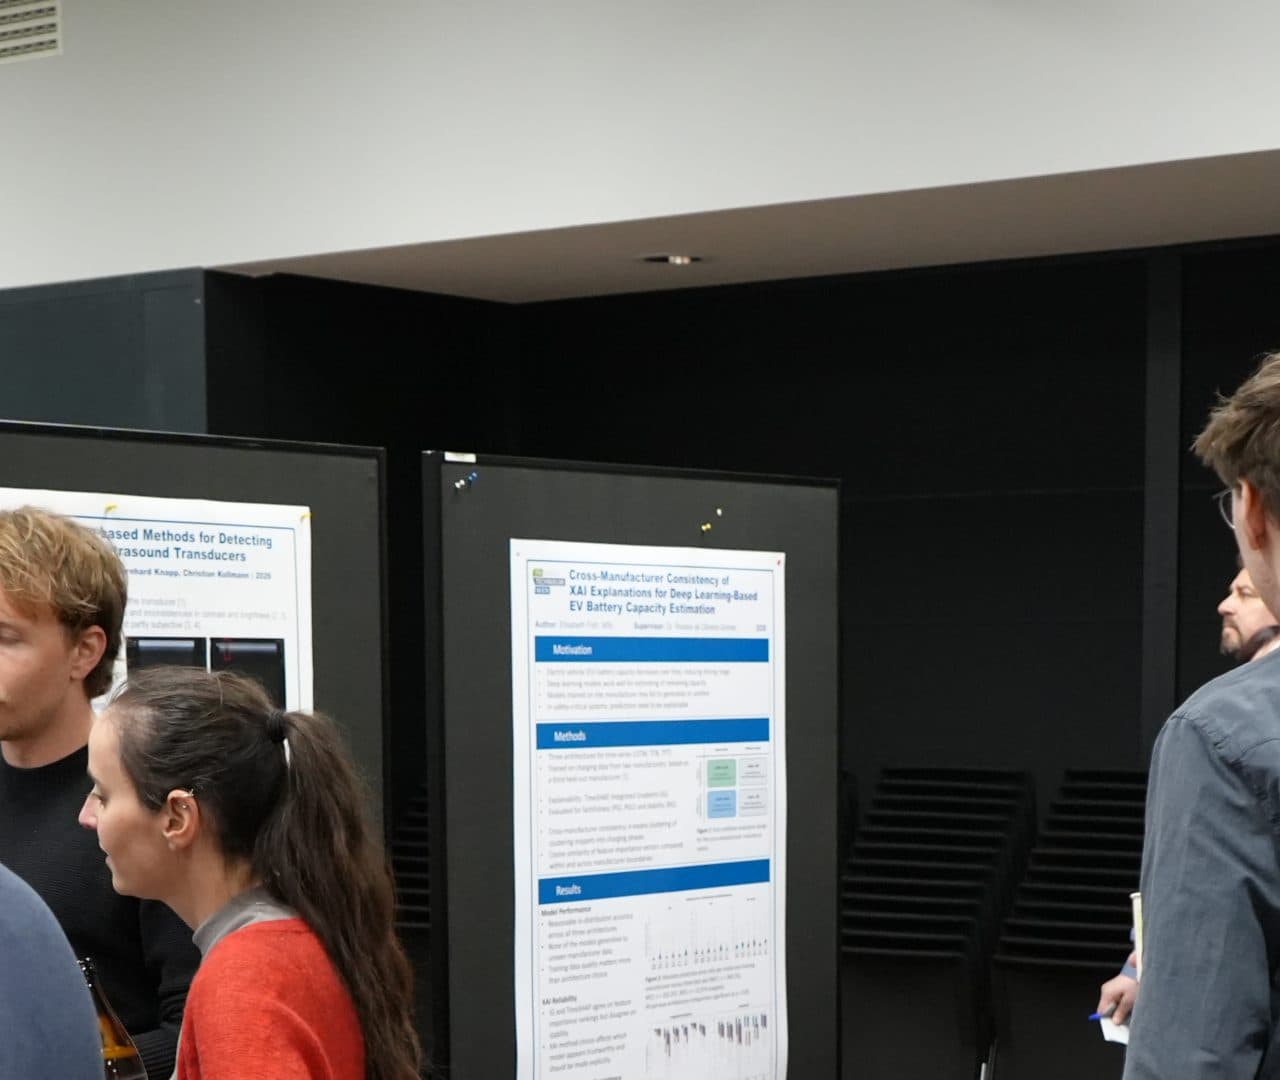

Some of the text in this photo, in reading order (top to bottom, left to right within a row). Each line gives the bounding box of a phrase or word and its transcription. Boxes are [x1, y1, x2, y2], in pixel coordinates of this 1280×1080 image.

[142, 529, 196, 543] Methods
[198, 531, 215, 544] for
[218, 532, 272, 548] Detecting
[174, 547, 245, 562] Transducers
[568, 569, 664, 584] Cross-Manufacturer
[666, 572, 719, 587] Consistency
[720, 574, 729, 586] of
[569, 585, 587, 597] XAI
[590, 586, 652, 600] Explanations
[654, 587, 667, 599] for
[670, 588, 692, 602] Deep
[569, 600, 715, 616] EV Battery Capacity Estimation
[554, 730, 586, 742] Methods
[556, 884, 581, 896] Results
